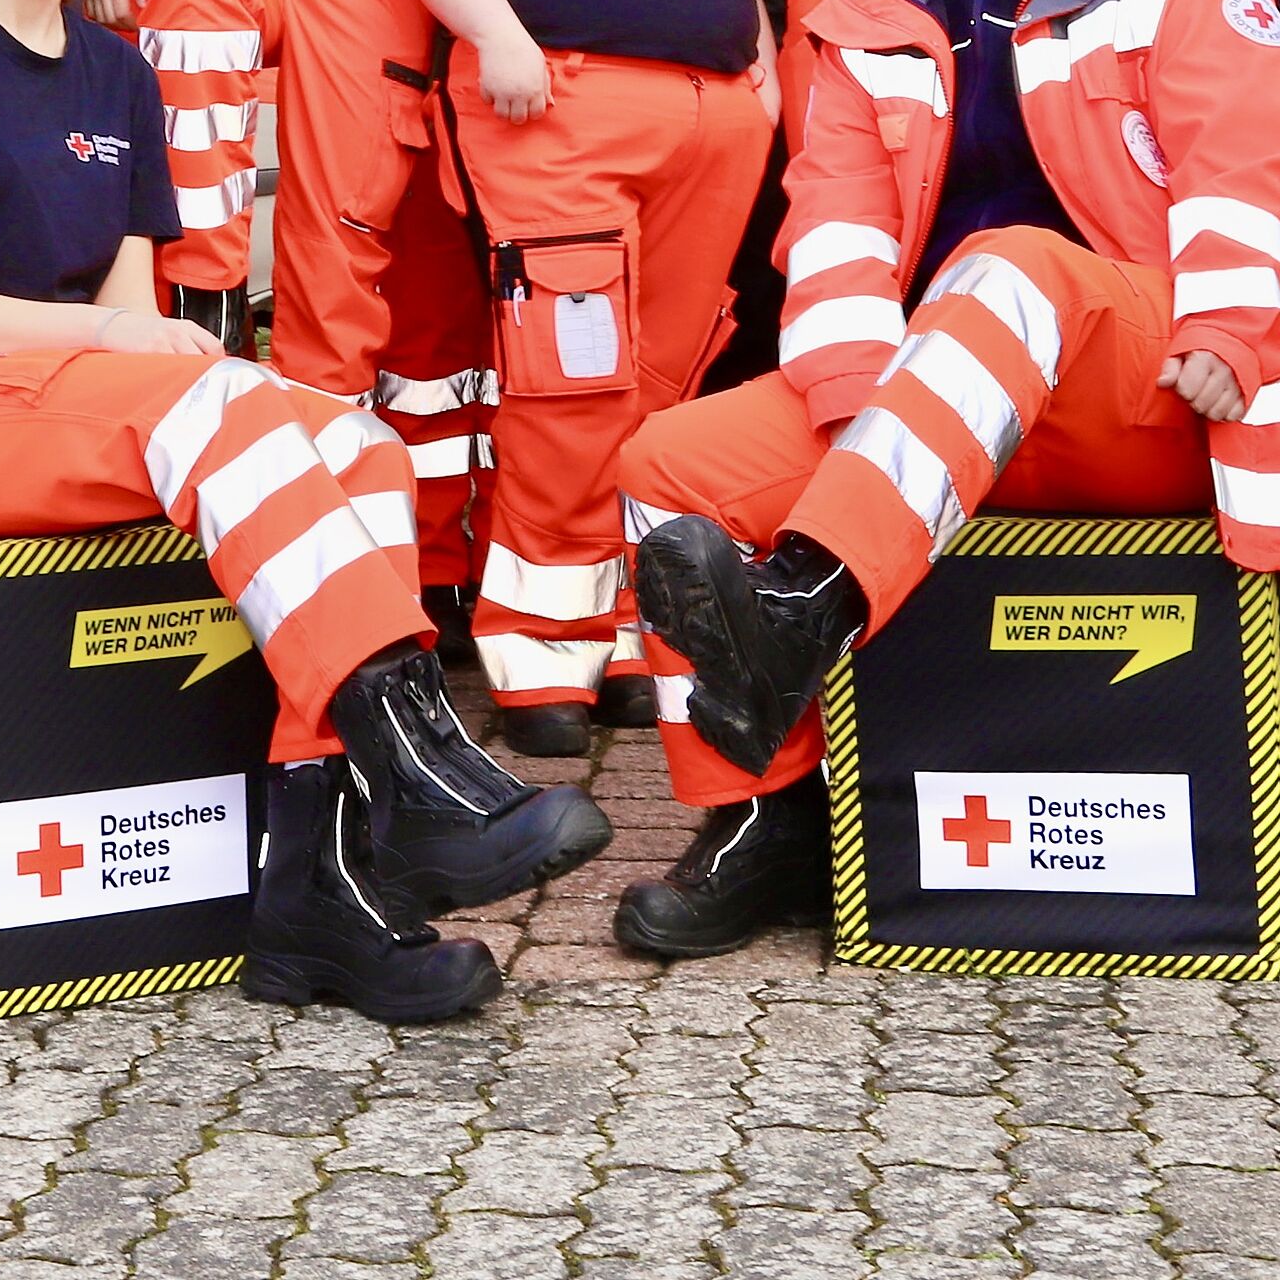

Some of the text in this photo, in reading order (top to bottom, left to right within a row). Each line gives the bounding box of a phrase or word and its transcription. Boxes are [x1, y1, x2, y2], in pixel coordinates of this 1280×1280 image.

[85, 616, 142, 636] WENN
[147, 609, 205, 629] NICHT
[1004, 605, 1186, 623] WENN NICHT WIR,
[85, 630, 198, 656] WER DANN?
[1005, 625, 1128, 641] WER DANN?
[100, 803, 227, 837] Deutsches
[1027, 795, 1167, 821] Deutsches
[1029, 822, 1105, 846] Rotes
[101, 838, 171, 864] Rotes
[1029, 849, 1107, 871] Kreuz
[101, 865, 172, 890] Kreuz
